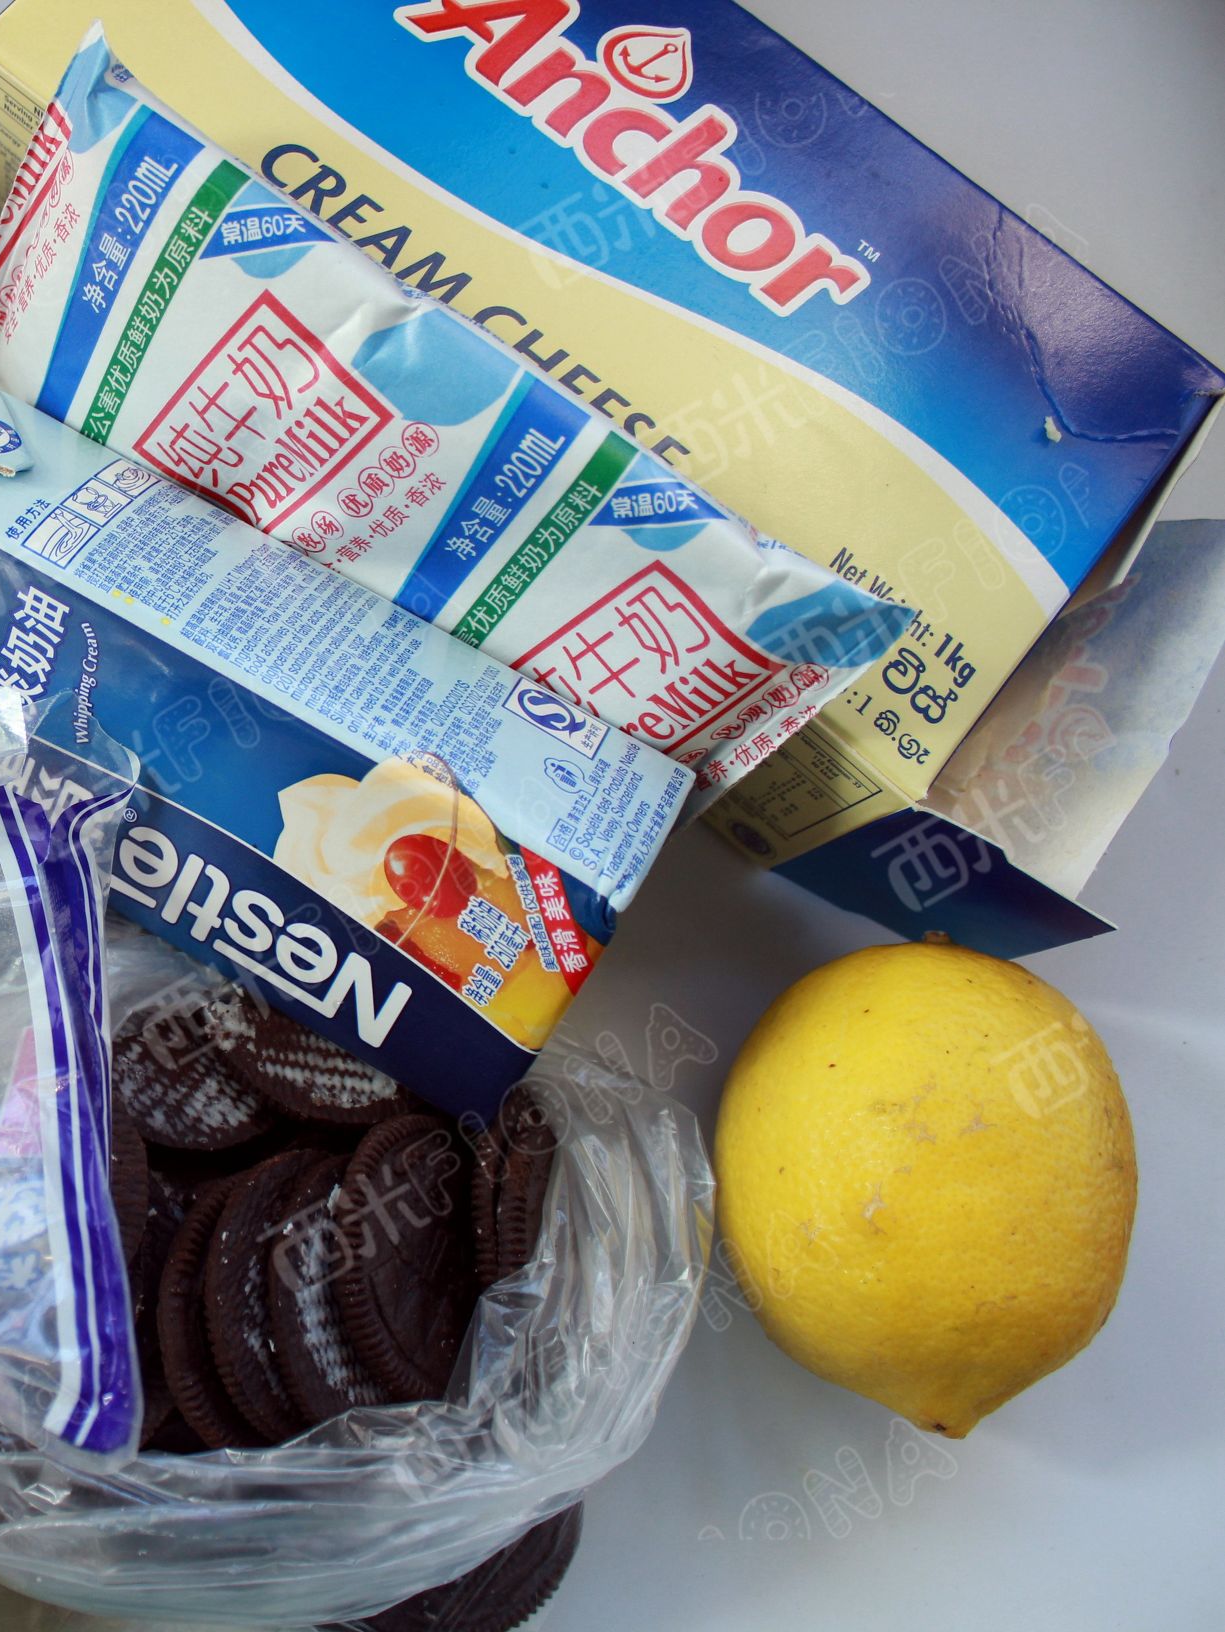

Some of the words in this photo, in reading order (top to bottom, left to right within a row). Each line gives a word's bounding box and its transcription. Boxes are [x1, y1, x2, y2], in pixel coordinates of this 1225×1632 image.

[404, 0, 862, 308] Anchor
[221, 203, 306, 245] 常温60天
[261, 143, 472, 304] CREAM
[158, 331, 324, 488] 纯牛奶
[228, 391, 369, 526] PureMilk
[5, 498, 49, 540] 使用方法
[611, 486, 697, 518] 常温60天
[230, 622, 271, 669] Ingredients:
[264, 608, 282, 626] Raw
[275, 592, 297, 613] bovine
[244, 653, 267, 677] food
[259, 624, 290, 657] additives
[281, 608, 303, 629] (soya
[382, 637, 402, 656] affect
[393, 629, 408, 642] the
[829, 547, 868, 586] Net
[934, 633, 976, 688] 1kg
[81, 622, 104, 682] Cream
[259, 639, 299, 686] diglycerides
[295, 621, 314, 637] fatty
[273, 671, 298, 695] (20)
[287, 645, 315, 675] sorbitan
[288, 645, 336, 702] microcrystalline
[327, 622, 356, 650] cellulose,
[304, 679, 336, 711] methyl
[348, 634, 369, 653] sugar
[364, 660, 383, 679] does
[375, 651, 391, 665] not
[74, 676, 97, 745] Whipping
[329, 696, 358, 725] Slight
[346, 712, 369, 735] only
[359, 692, 380, 715] need
[377, 675, 393, 689] stir
[385, 663, 402, 679] well
[394, 647, 415, 668] before
[348, 675, 374, 701] caking
[623, 656, 751, 748] reMilk
[593, 795, 612, 815] des
[598, 814, 621, 844] Vevey,
[611, 768, 644, 818] Switzerland.
[601, 763, 629, 799] Produits
[550, 821, 573, 848] 合格
[597, 829, 635, 883] Trademark
[624, 798, 651, 833] Owners
[534, 871, 573, 926] 美味
[115, 825, 413, 1049] Nestlé
